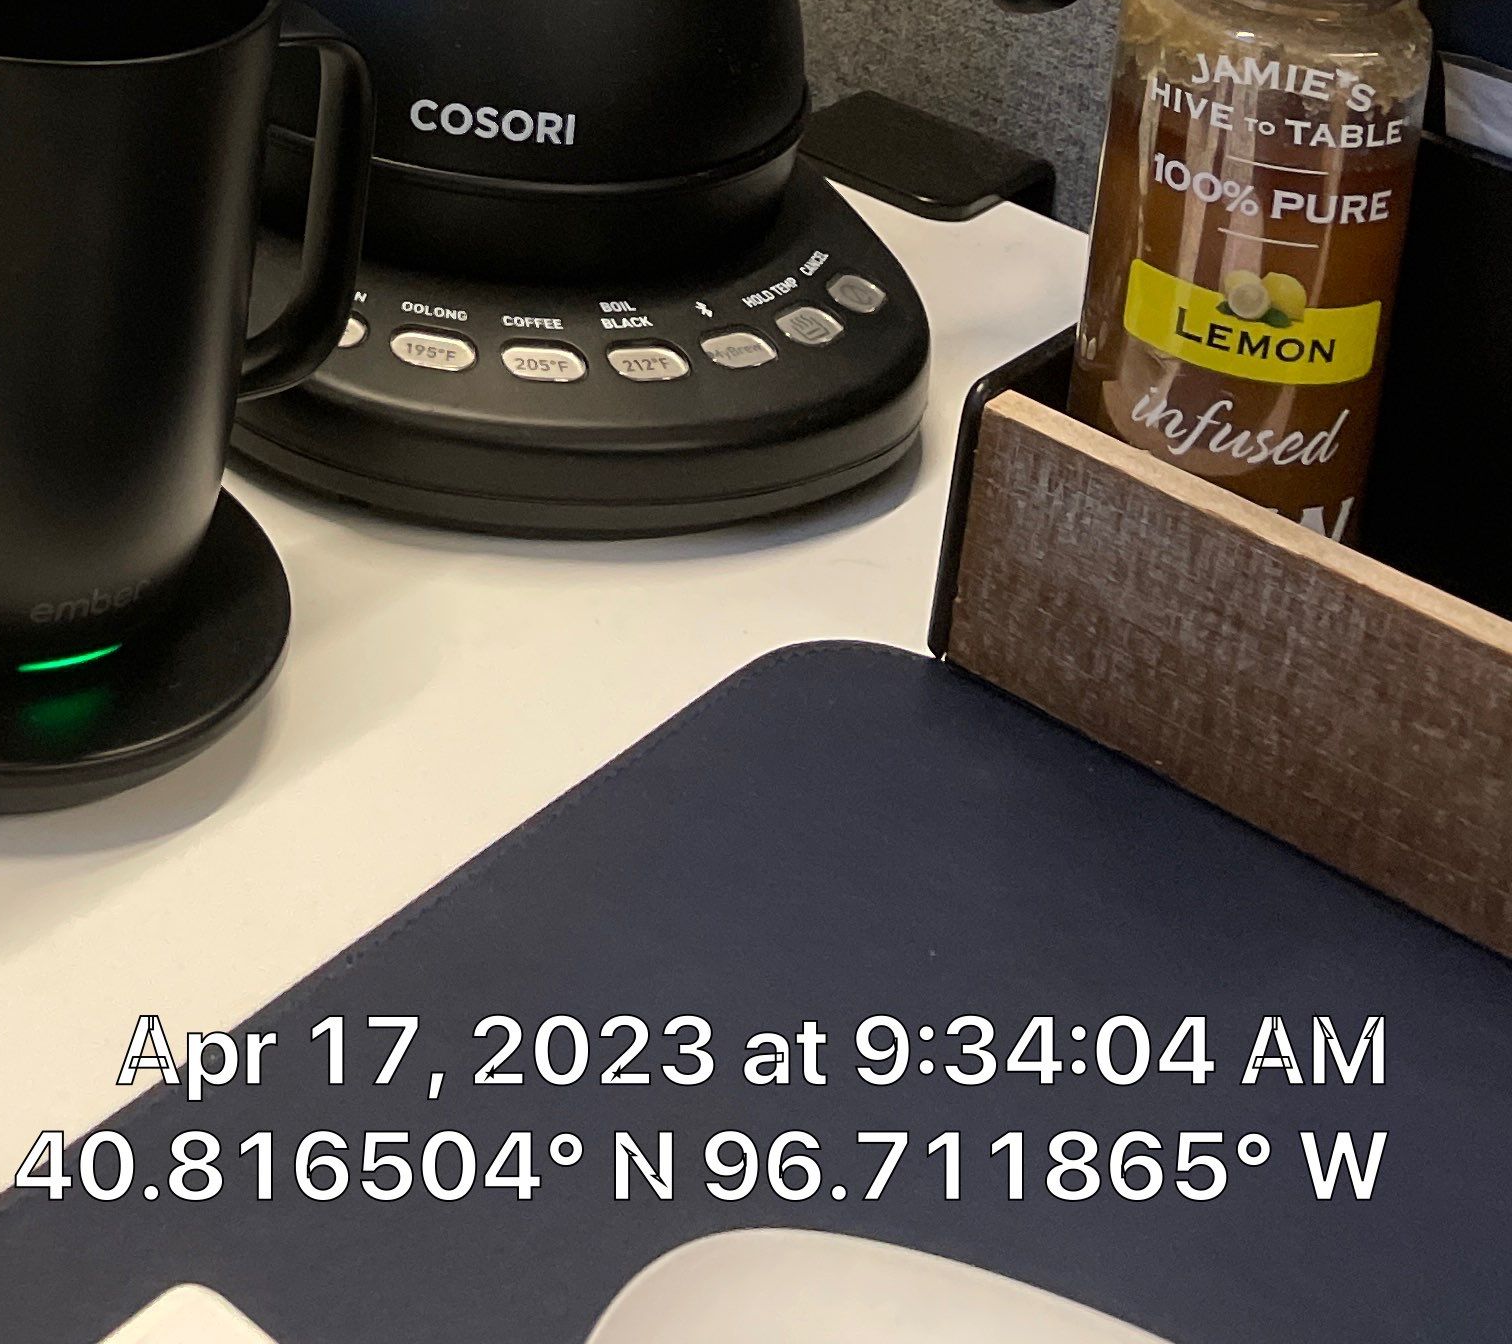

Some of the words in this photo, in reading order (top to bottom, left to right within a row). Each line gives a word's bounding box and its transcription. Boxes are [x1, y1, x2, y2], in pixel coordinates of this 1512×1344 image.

[409, 97, 576, 146] COSORI
[1150, 76, 1235, 132] HIVE
[1284, 117, 1405, 150] TABLE
[1153, 152, 1260, 217] 100%
[1269, 188, 1393, 225] PURE
[598, 300, 637, 314] BOIL
[741, 291, 776, 309] HOLD
[770, 276, 799, 298] TEMP
[400, 300, 469, 322] OOLONG
[502, 314, 564, 331] COFFEE
[600, 315, 654, 330] BLACK
[405, 342, 457, 362] 195°F
[1173, 306, 1337, 365] LEMON
[514, 356, 570, 373] 205°F
[1130, 384, 1349, 467] infused
[29, 579, 151, 624] ember
